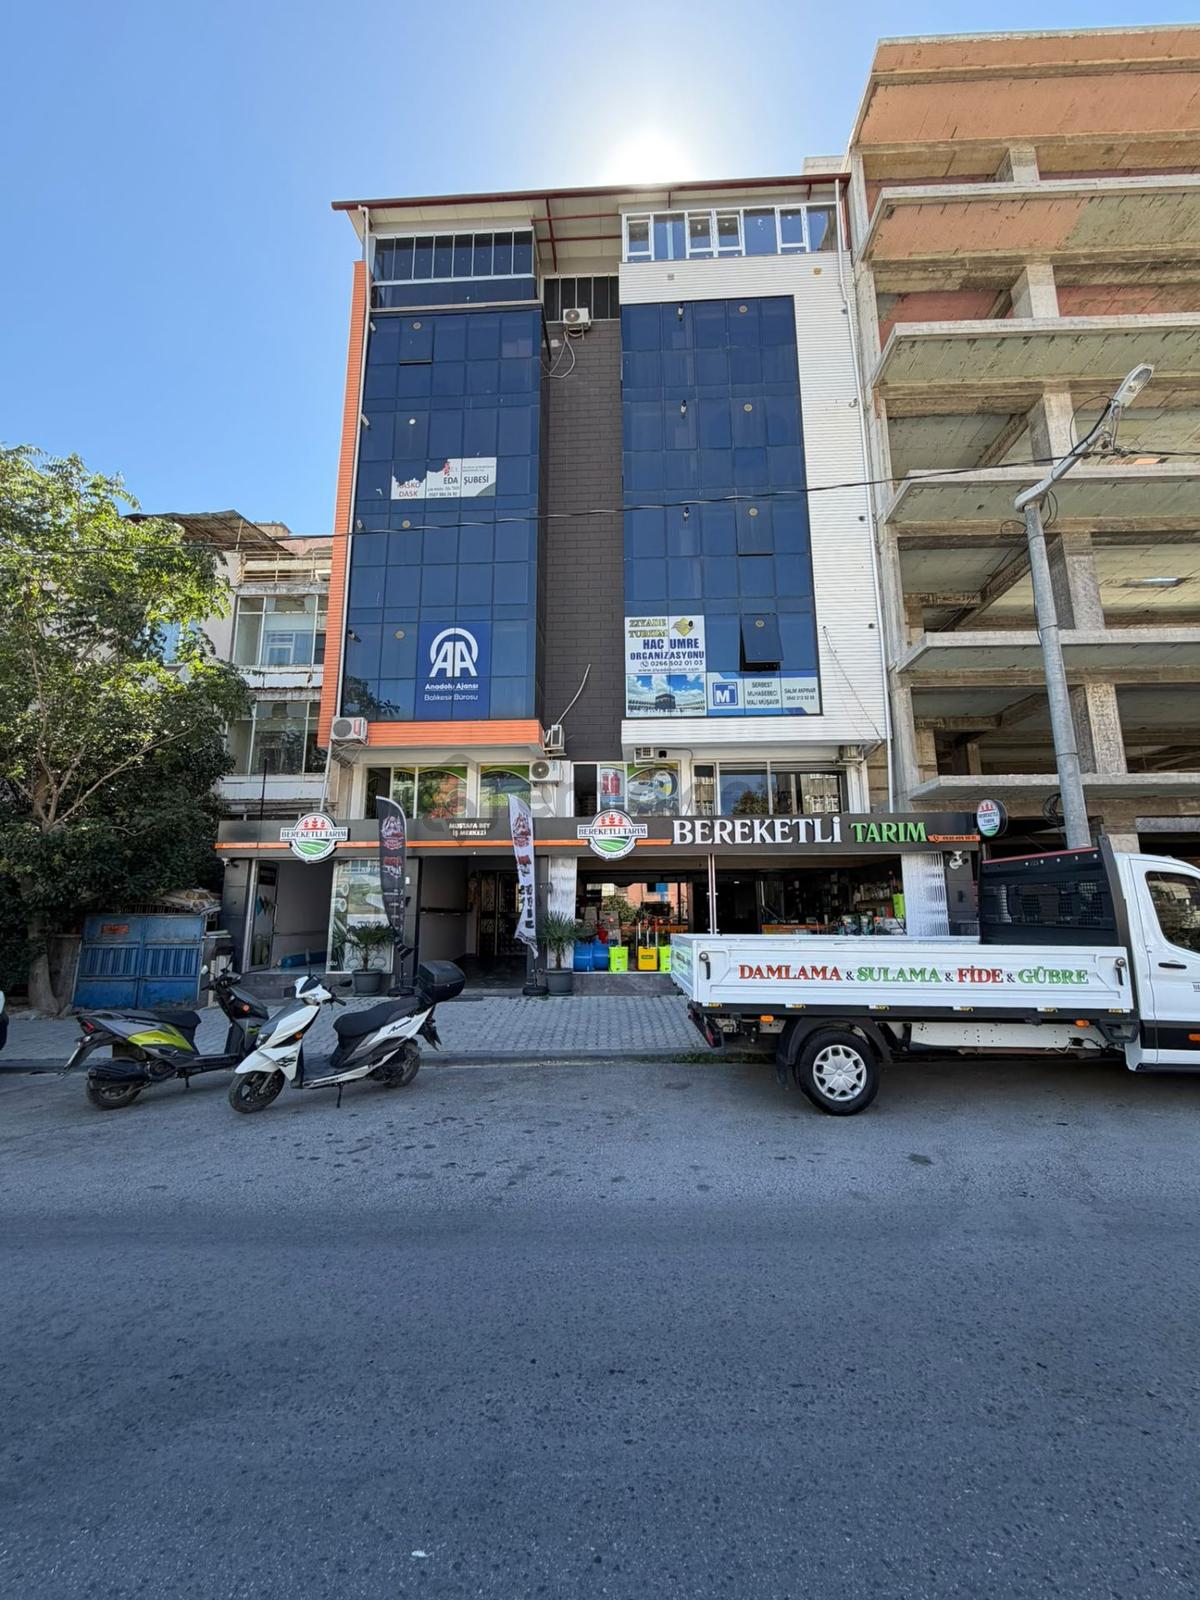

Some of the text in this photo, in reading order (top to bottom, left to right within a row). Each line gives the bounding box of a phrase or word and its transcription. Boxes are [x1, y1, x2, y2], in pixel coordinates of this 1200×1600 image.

[443, 475, 489, 485] EDA ŞUBESİ
[398, 490, 418, 498] DASK
[643, 638, 699, 649] HAC UMRE
[630, 650, 705, 660] ORGANİZASYONU
[425, 683, 455, 691] Anadolu
[623, 827, 647, 835] TARIM
[850, 822, 927, 843] TARIM
[739, 964, 1089, 985] DAMLAMA & SULAMA & FİDE & GÜBRE
